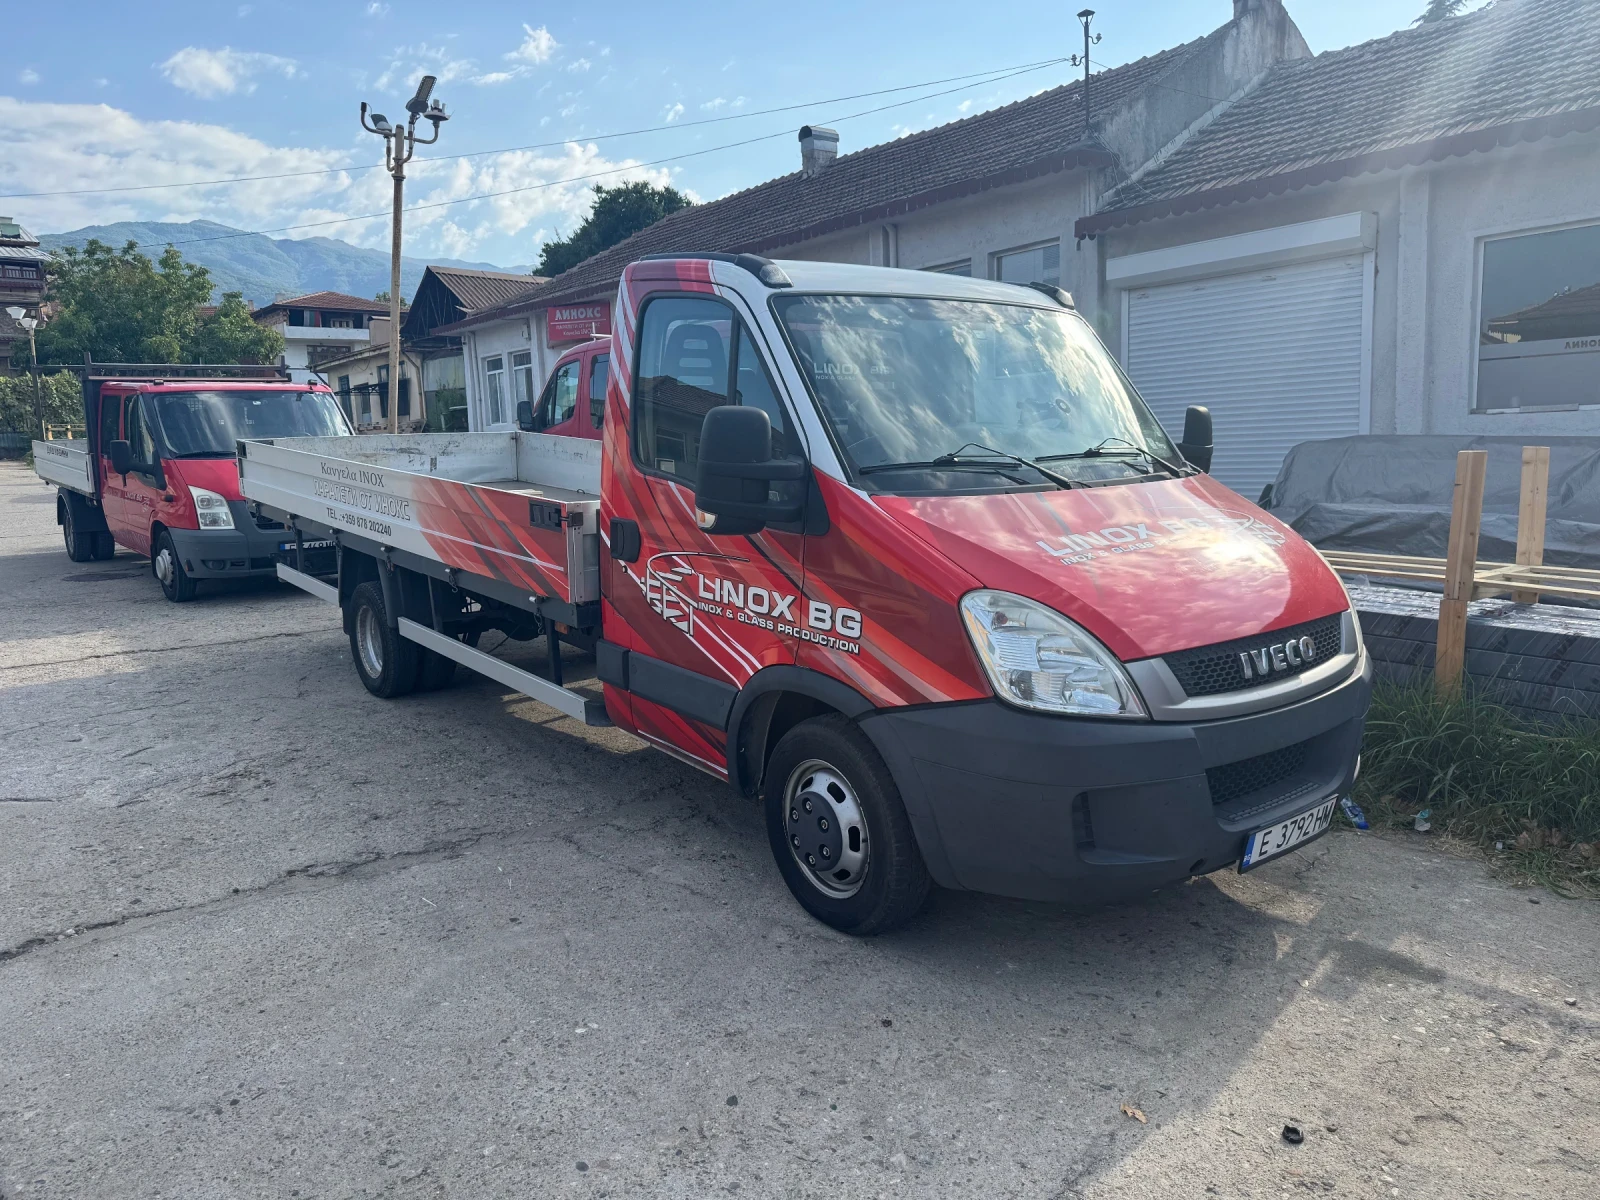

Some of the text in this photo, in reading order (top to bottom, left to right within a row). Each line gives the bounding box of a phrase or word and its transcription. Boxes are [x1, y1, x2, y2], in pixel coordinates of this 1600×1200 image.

[555, 307, 601, 320] ЛИНОКС
[1564, 339, 1600, 349] ЛИНО
[359, 470, 384, 488] INOX
[313, 479, 410, 521] ПАРАПЕТИ ОТ ИНОКС
[357, 517, 368, 529] 878
[369, 520, 391, 537] 202240
[1036, 523, 1162, 557] LINOX
[1060, 553, 1096, 566] INOX
[1111, 541, 1155, 554] GLASS
[698, 573, 862, 639] LINOX BG
[698, 602, 860, 654] INOX & GLASS PRODUCTION
[1240, 636, 1317, 679] IVECO
[1259, 829, 1273, 857] E
